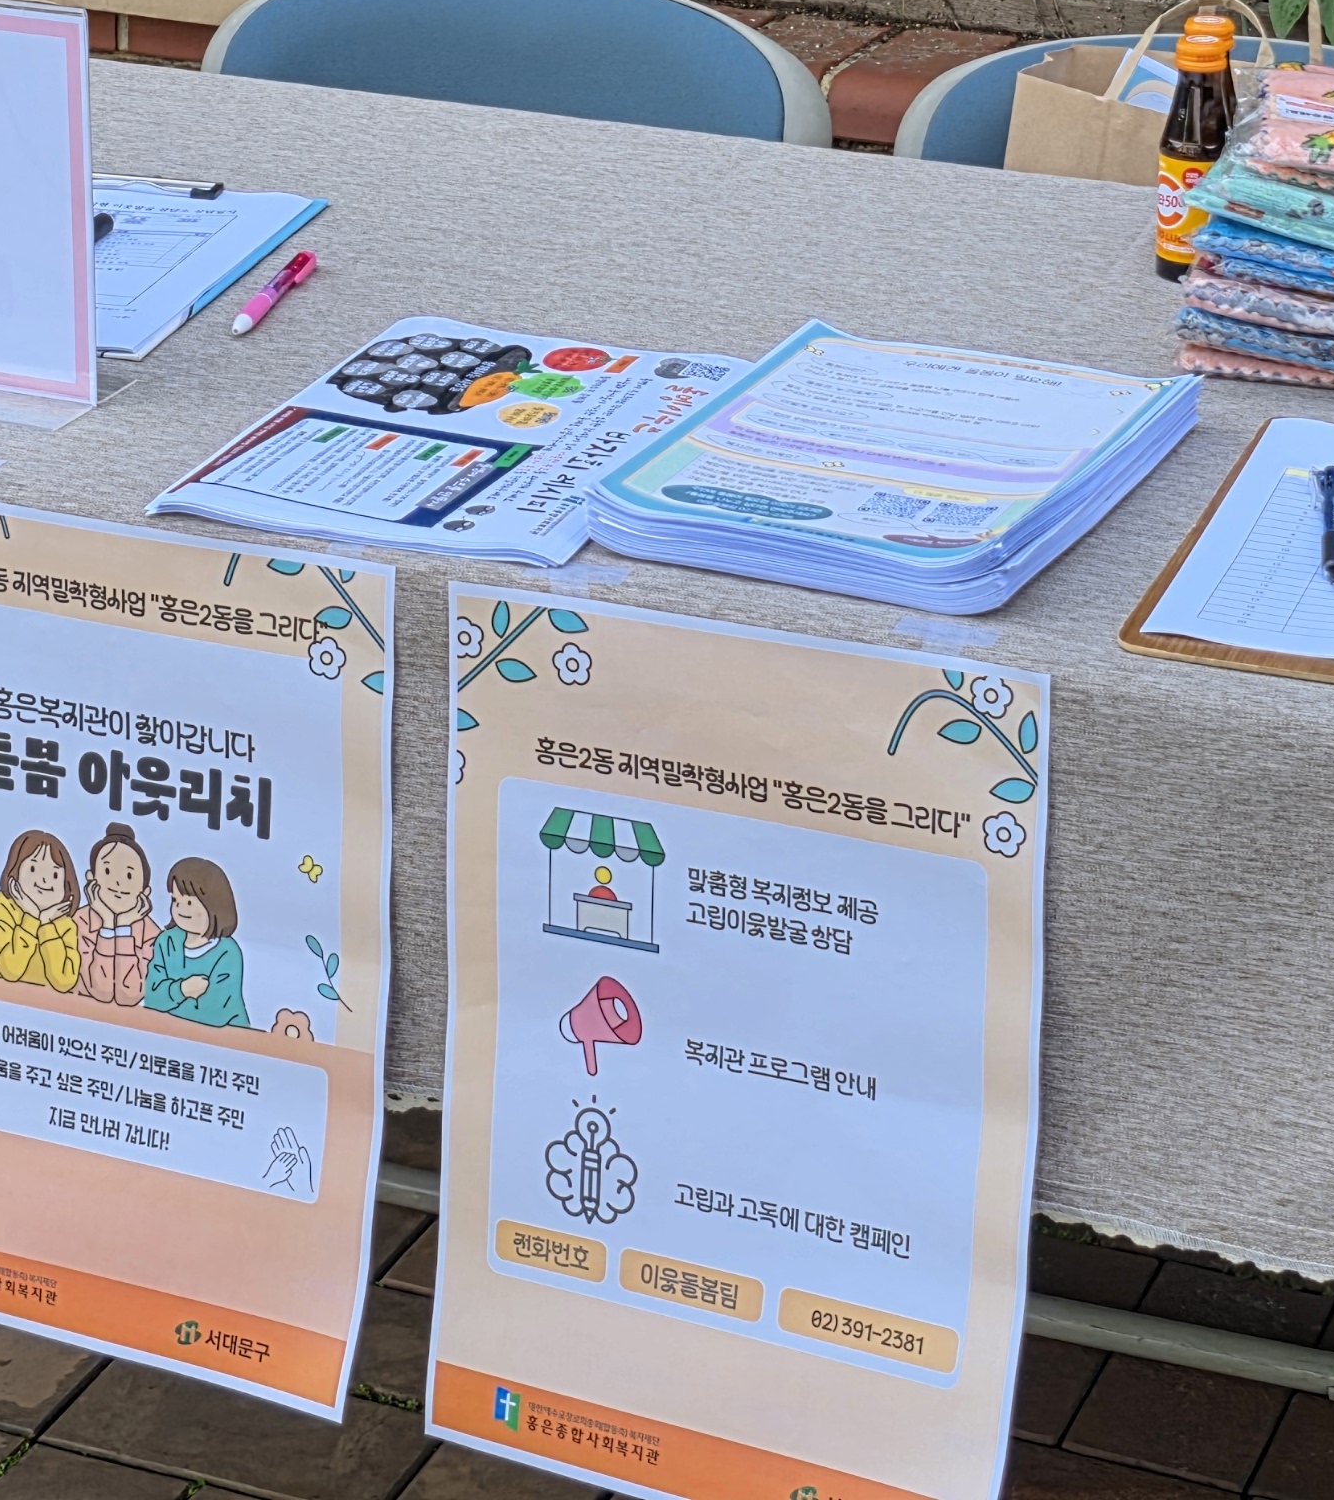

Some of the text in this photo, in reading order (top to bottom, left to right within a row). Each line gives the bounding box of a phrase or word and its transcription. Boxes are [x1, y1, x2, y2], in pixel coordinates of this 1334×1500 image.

[516, 473, 576, 513] 레시피
[12, 571, 146, 617] 지역밀착형사업
[150, 593, 254, 635] "홍은2동을
[256, 612, 328, 642] 그리다"
[135, 713, 255, 763] 찾아갑니다
[78, 749, 272, 840] 아웃리치
[534, 736, 971, 839] 홍은2동 지역밀착형사업 "홍은2동을 그리다"
[688, 867, 879, 925] 맞춤형 복지정보 제공
[686, 902, 853, 955] 고립이웃발굴 상담
[2, 1025, 54, 1053] 어려움이
[58, 1036, 97, 1061] 있으신
[199, 1065, 227, 1089] 가진
[231, 1071, 260, 1096] 주민
[684, 1039, 877, 1101] 복지관 프로그램 안내
[26, 1065, 52, 1089] 주고
[56, 1071, 83, 1095] 싶은
[171, 1096, 213, 1124] 하고픈
[217, 1105, 245, 1130] 주민
[49, 1106, 170, 1151] 지금 만나러 갑니다!
[674, 1183, 912, 1260] 고립과 고독에 대한 캠페인
[513, 1232, 590, 1271] 전화번호
[640, 1263, 740, 1310] 이웃돌봄팀
[205, 1329, 270, 1363] 서대문구
[526, 1414, 660, 1466] 홍은종합사회복지관
